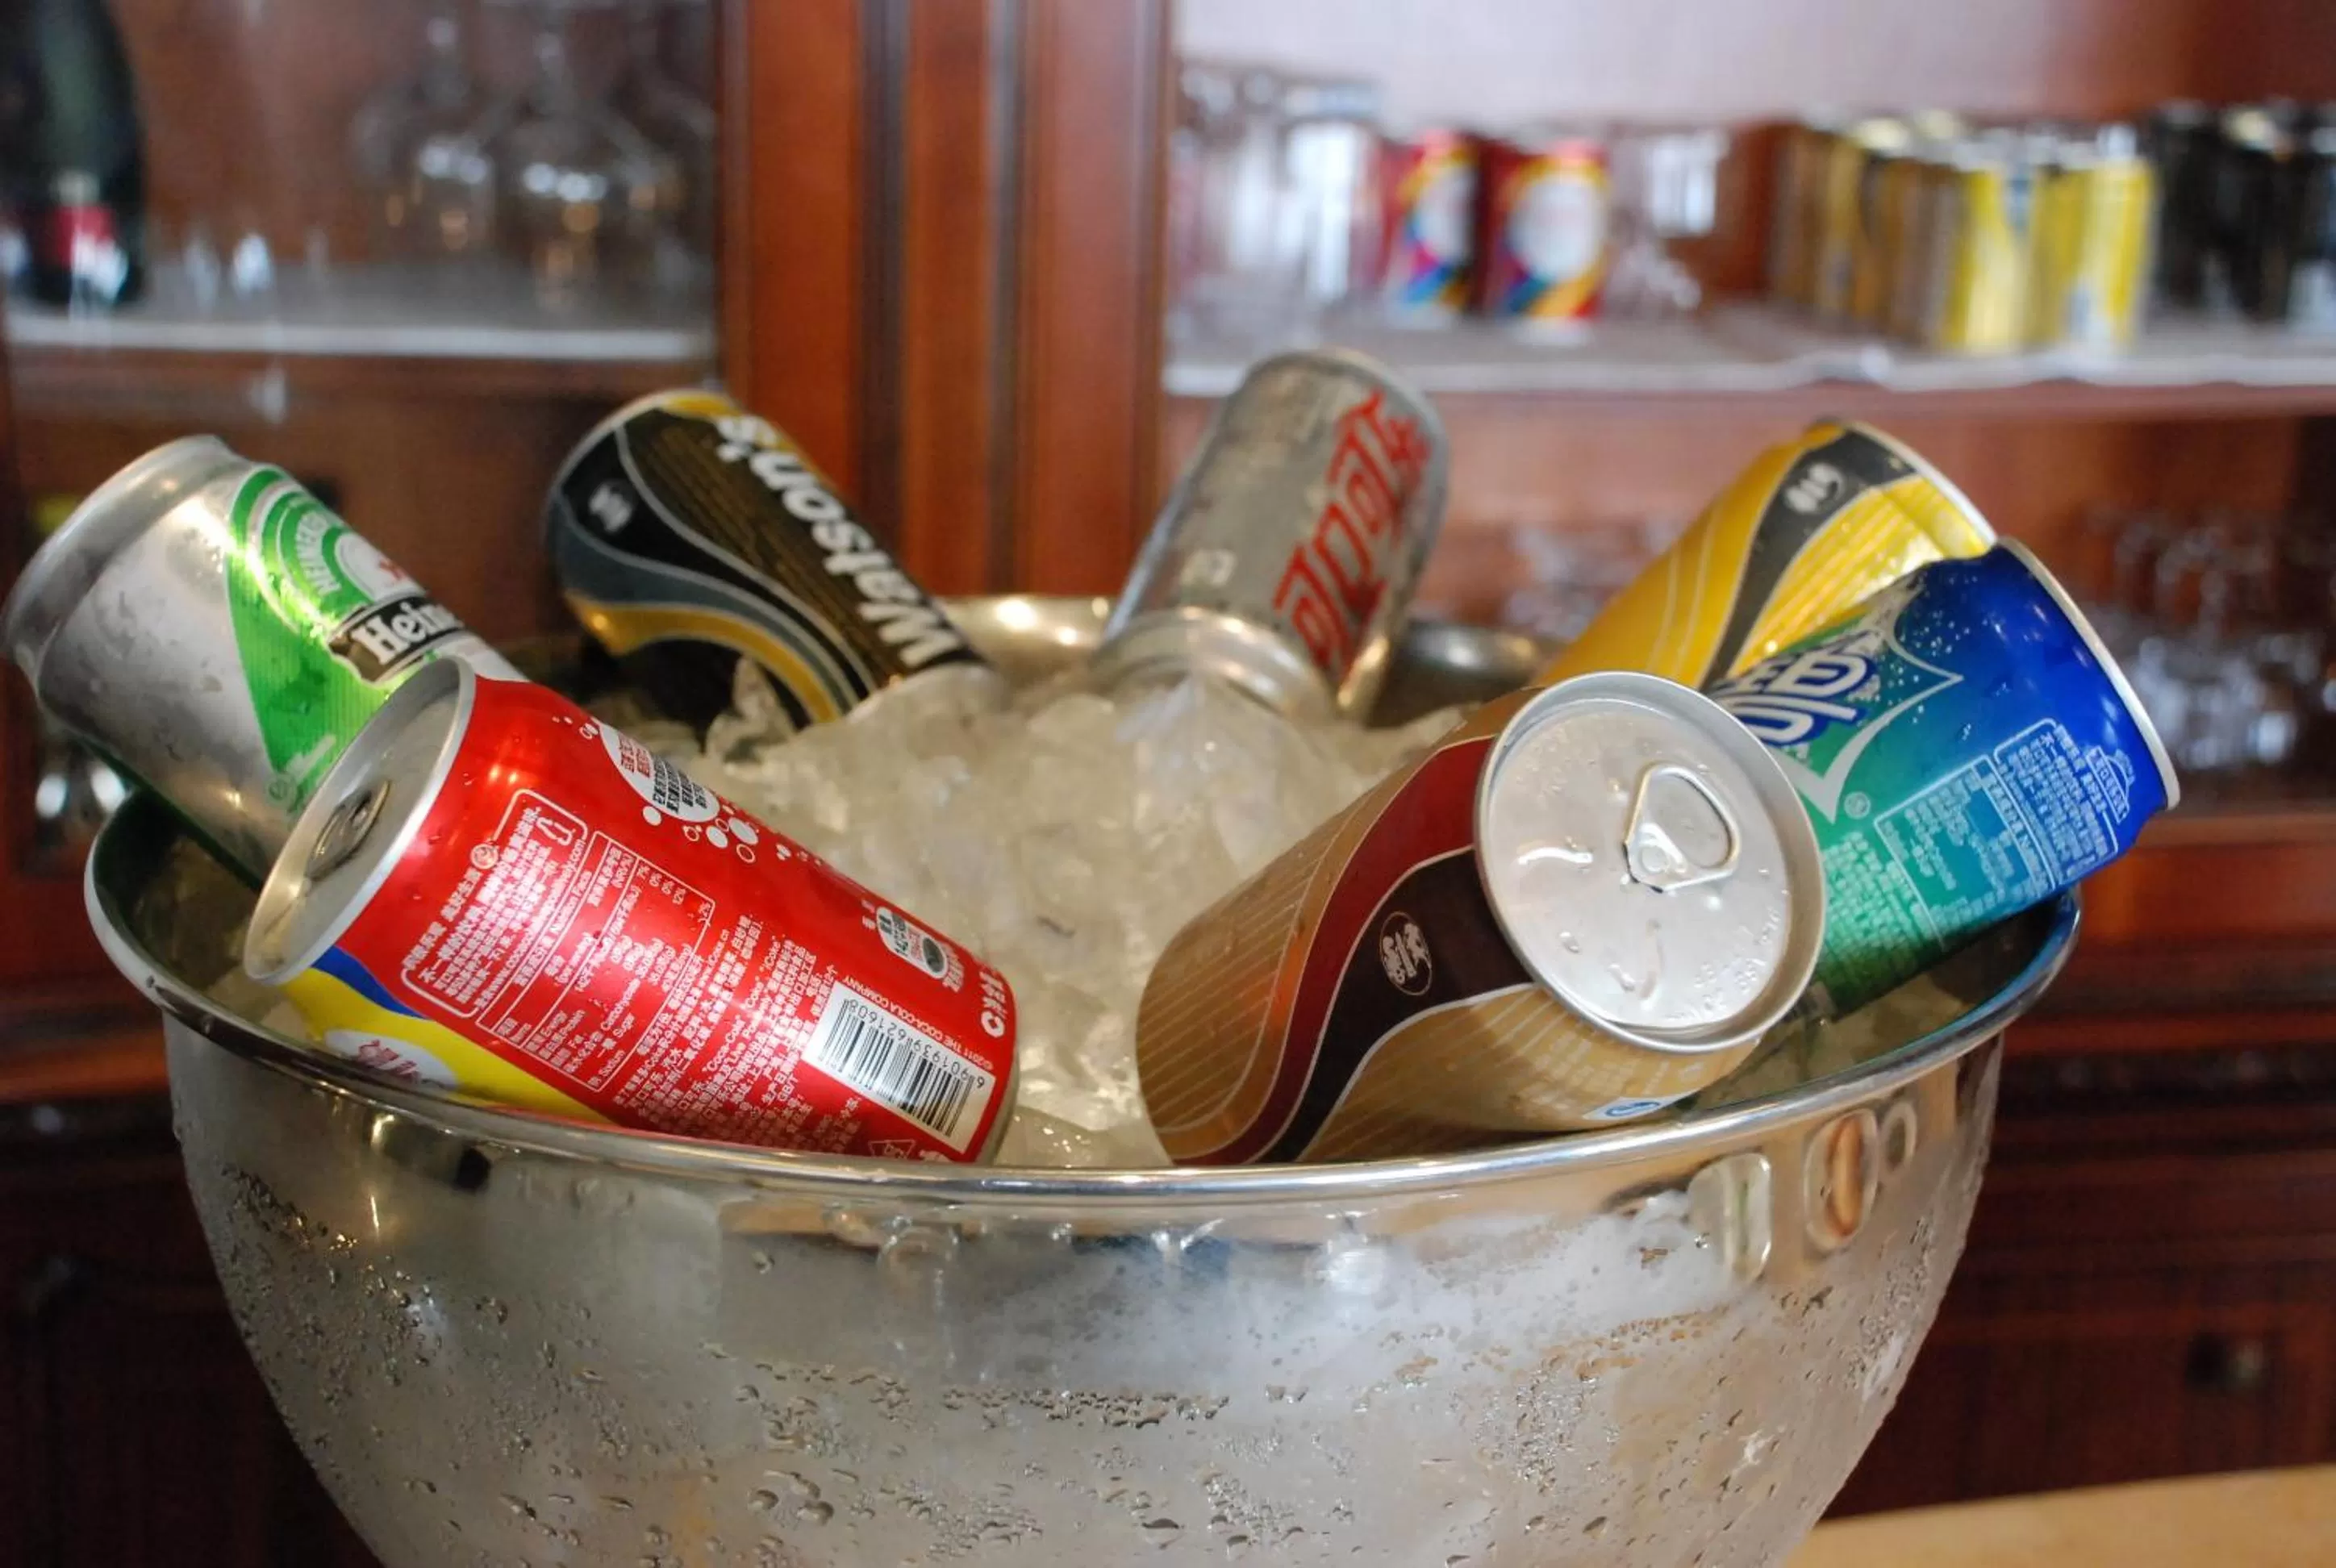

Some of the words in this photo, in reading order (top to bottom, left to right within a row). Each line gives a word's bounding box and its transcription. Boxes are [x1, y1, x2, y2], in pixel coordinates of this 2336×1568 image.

[714, 415, 962, 668] Watson's
[841, 973, 891, 1008] COMPANY
[844, 996, 909, 1043] 621608
[887, 1001, 945, 1041] COCA-COLA
[908, 1036, 972, 1082] 901939
[941, 1035, 963, 1053] THE
[973, 1074, 987, 1089] 6
